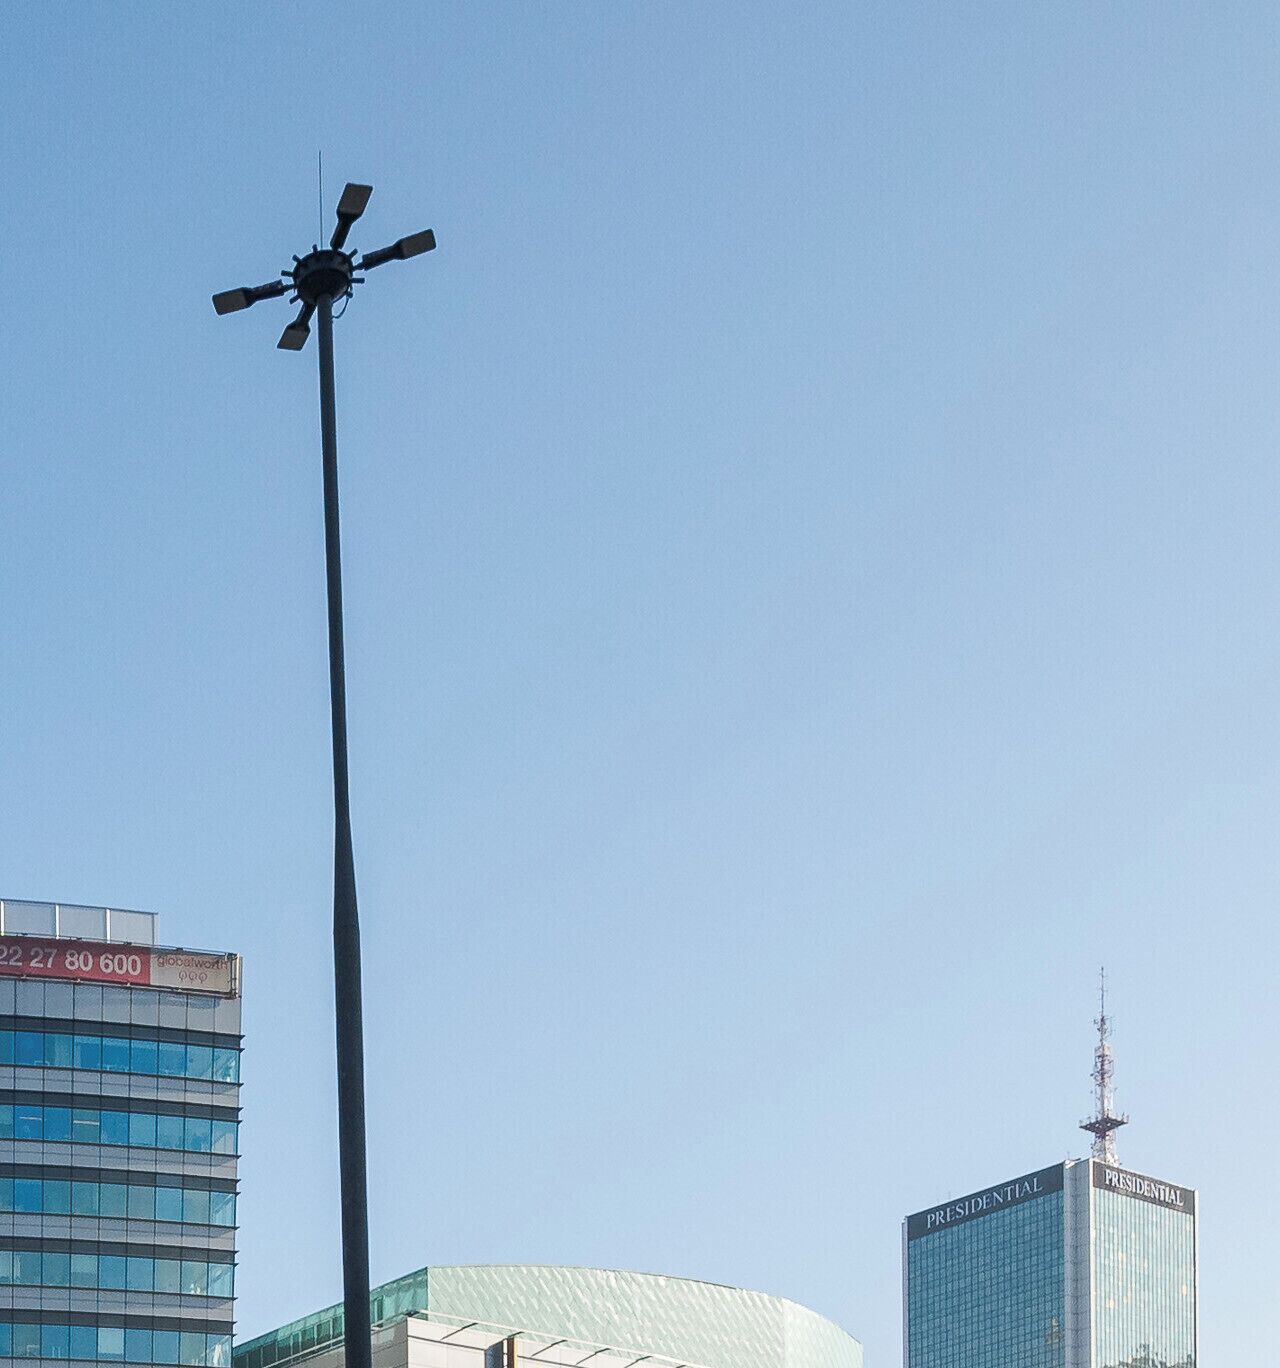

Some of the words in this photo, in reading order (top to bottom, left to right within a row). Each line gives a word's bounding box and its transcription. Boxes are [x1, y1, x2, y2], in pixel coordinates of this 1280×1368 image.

[29, 947, 58, 968] 27
[64, 950, 94, 971] 80
[99, 952, 142, 976] 600
[156, 954, 229, 971] globalworth
[926, 1176, 1044, 1229] PRESIDENTIAL
[1104, 1168, 1185, 1207] PRESIDENTIAL
